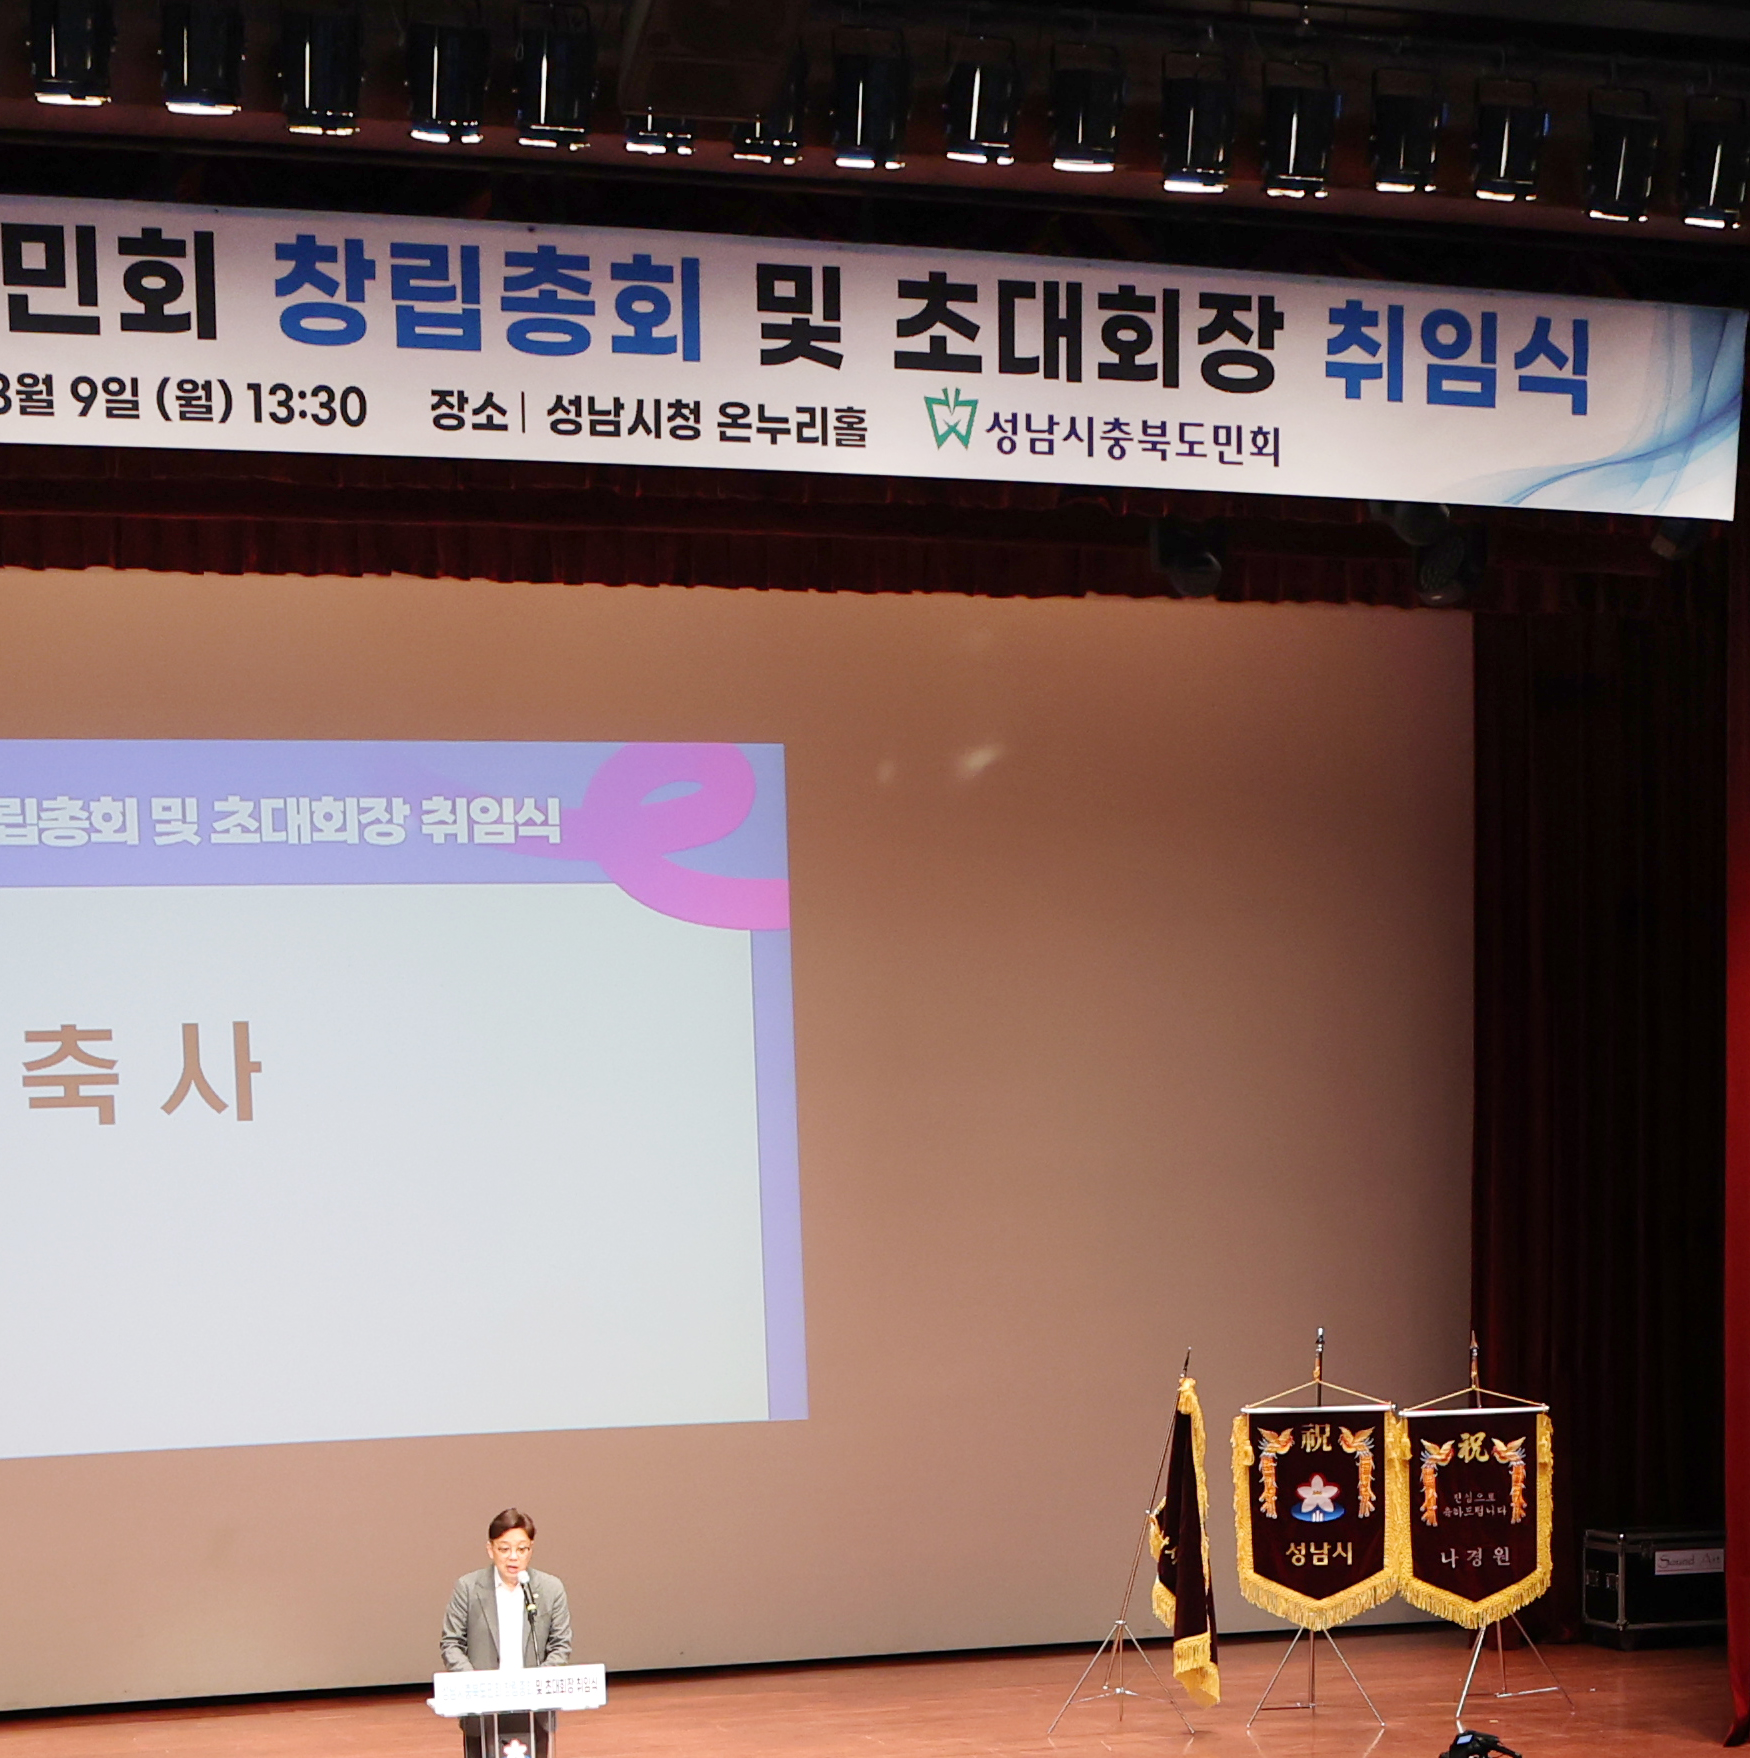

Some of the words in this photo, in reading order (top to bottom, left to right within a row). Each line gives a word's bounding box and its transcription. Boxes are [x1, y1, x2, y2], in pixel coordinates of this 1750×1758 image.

[275, 234, 700, 362] 창립총회
[755, 262, 844, 370] 및
[894, 272, 1284, 393] 초대회장
[1325, 299, 1591, 415] 취임식
[71, 376, 141, 419] 9일
[247, 383, 367, 427] 13:30
[430, 389, 508, 432] 장소
[547, 394, 701, 441] 성남시청
[716, 401, 868, 448] 온누리홀
[986, 411, 1280, 467] 성남시충북도민회
[152, 797, 201, 846] 및
[210, 795, 411, 846] 초대회장
[421, 796, 562, 844] 취임식
[1301, 1423, 1332, 1453] 祝
[1457, 1431, 1489, 1463] 祝
[1286, 1542, 1353, 1566] 성남시
